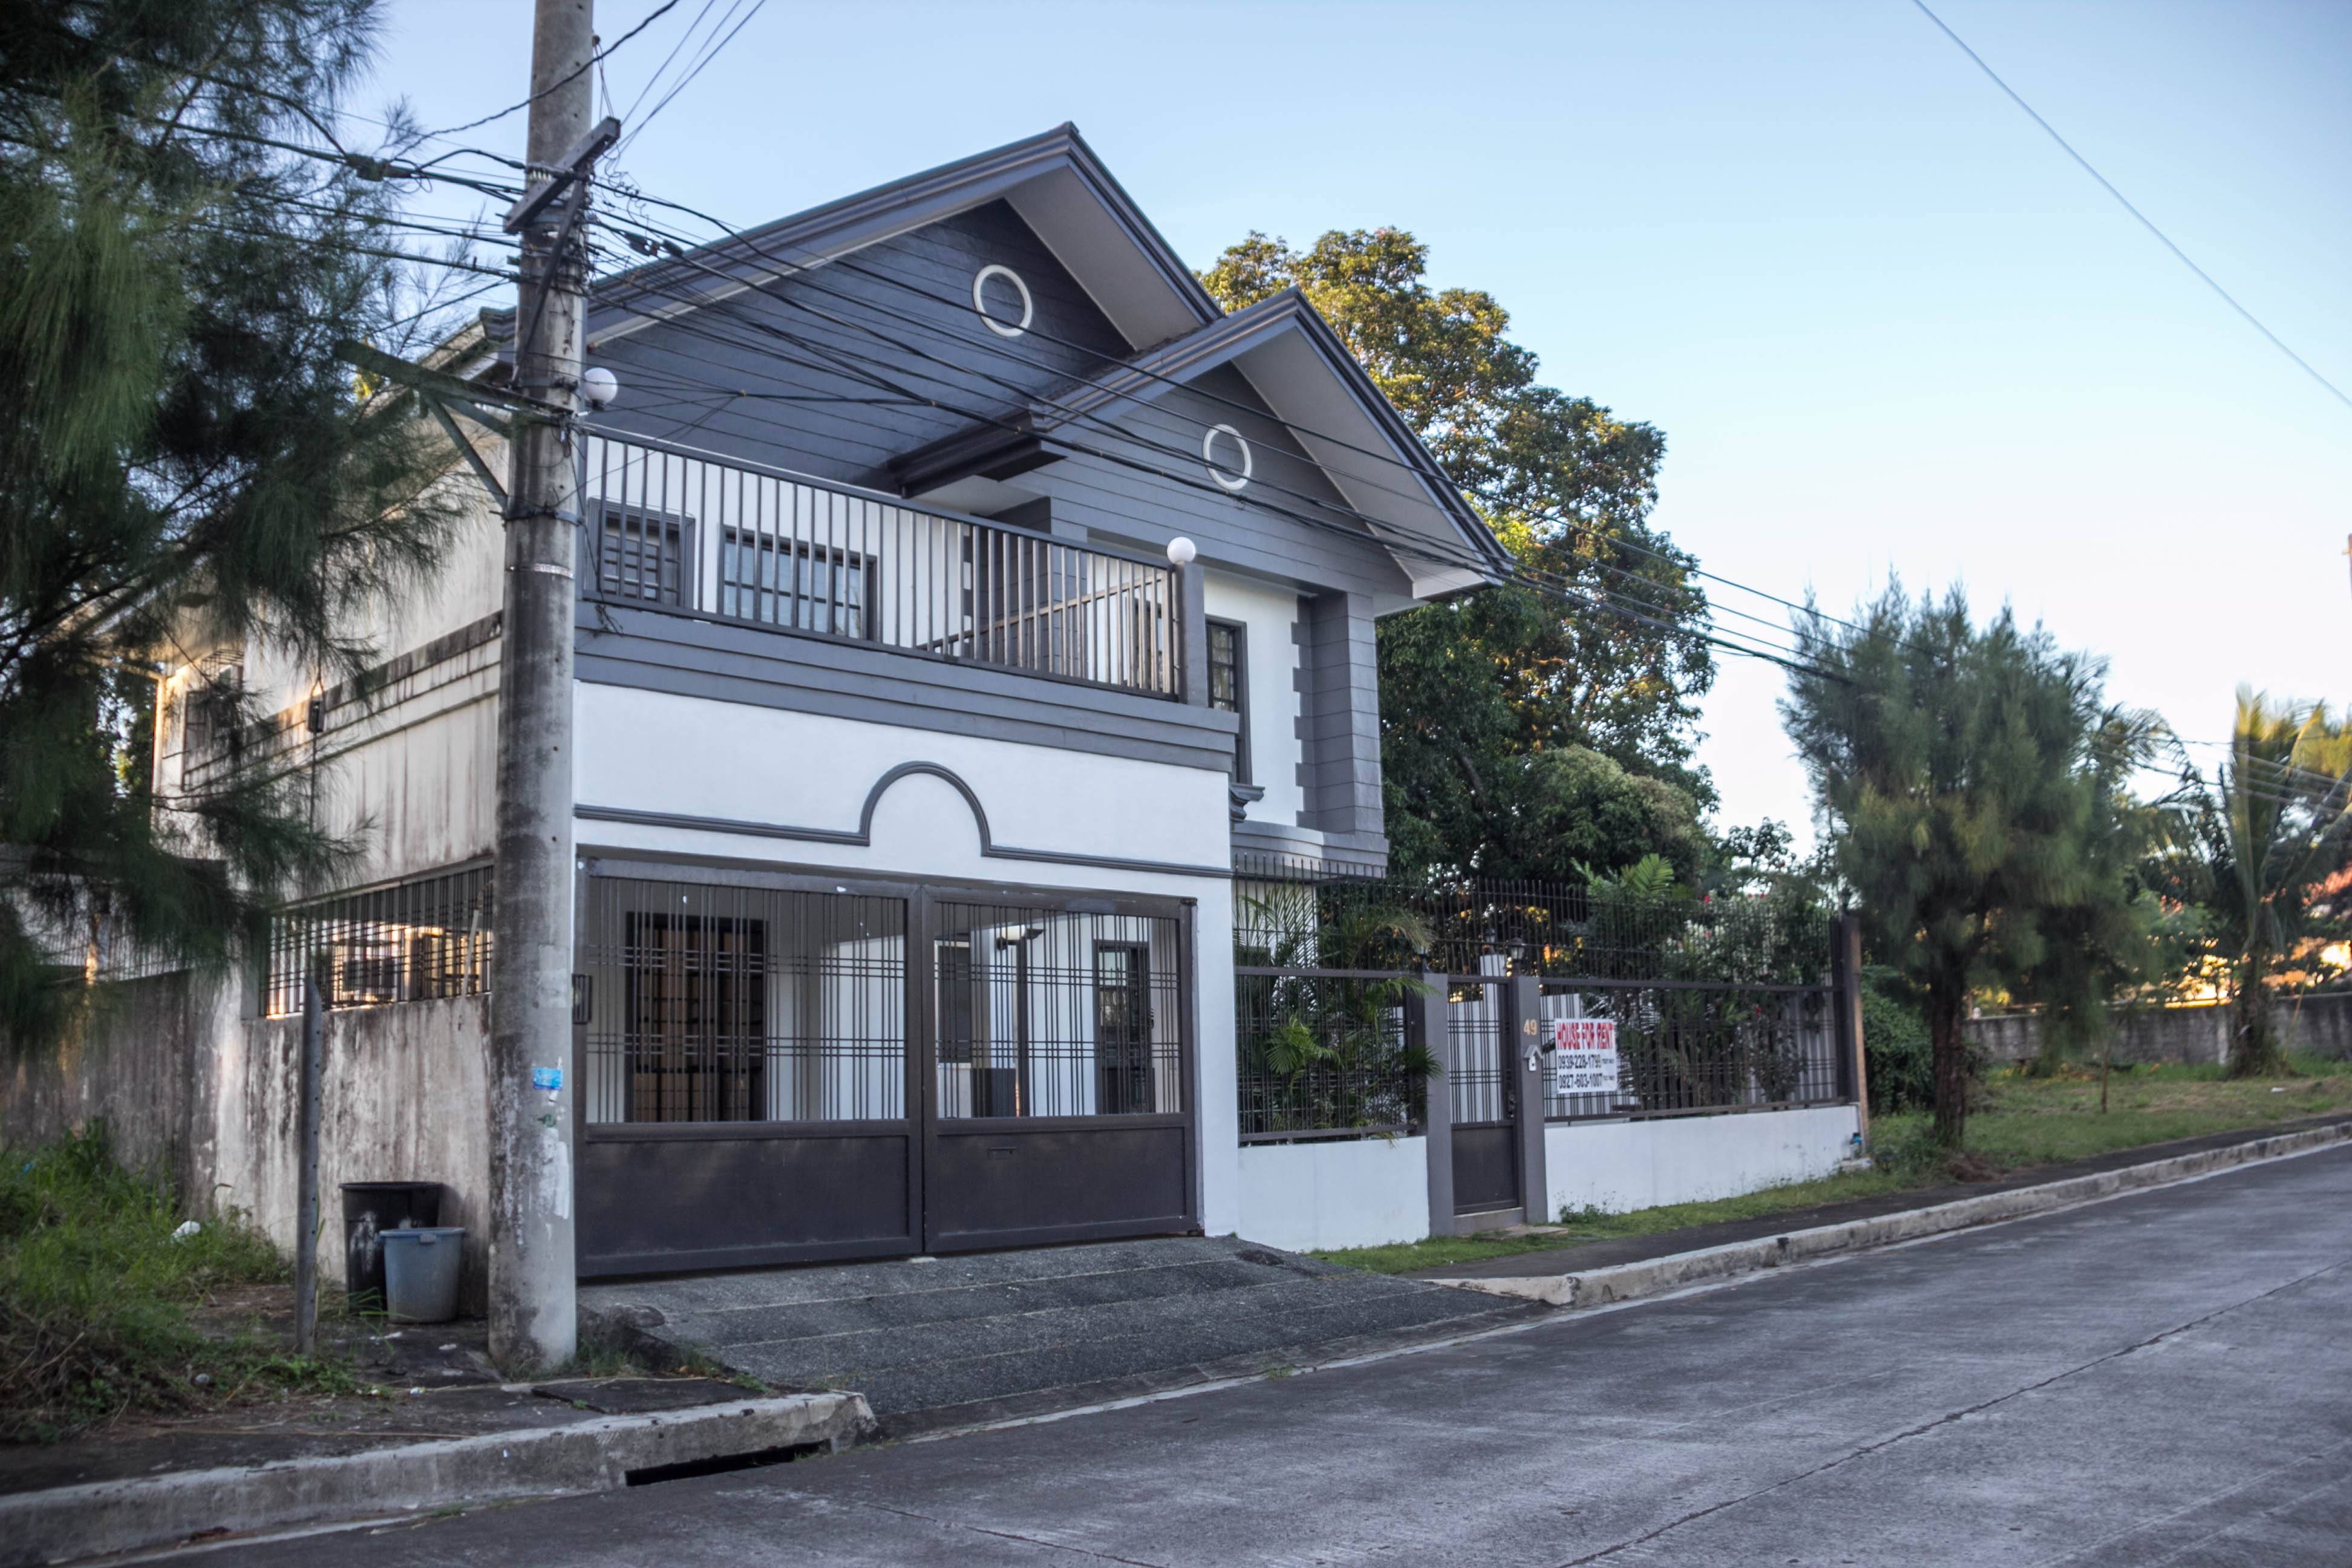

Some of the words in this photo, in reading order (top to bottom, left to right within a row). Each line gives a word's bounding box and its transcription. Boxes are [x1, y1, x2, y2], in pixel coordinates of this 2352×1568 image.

[1523, 1019, 1537, 1036] 49
[1556, 1022, 1580, 1050] HOUSE
[1581, 1022, 1595, 1050] FOR
[1597, 1022, 1613, 1050] RENT
